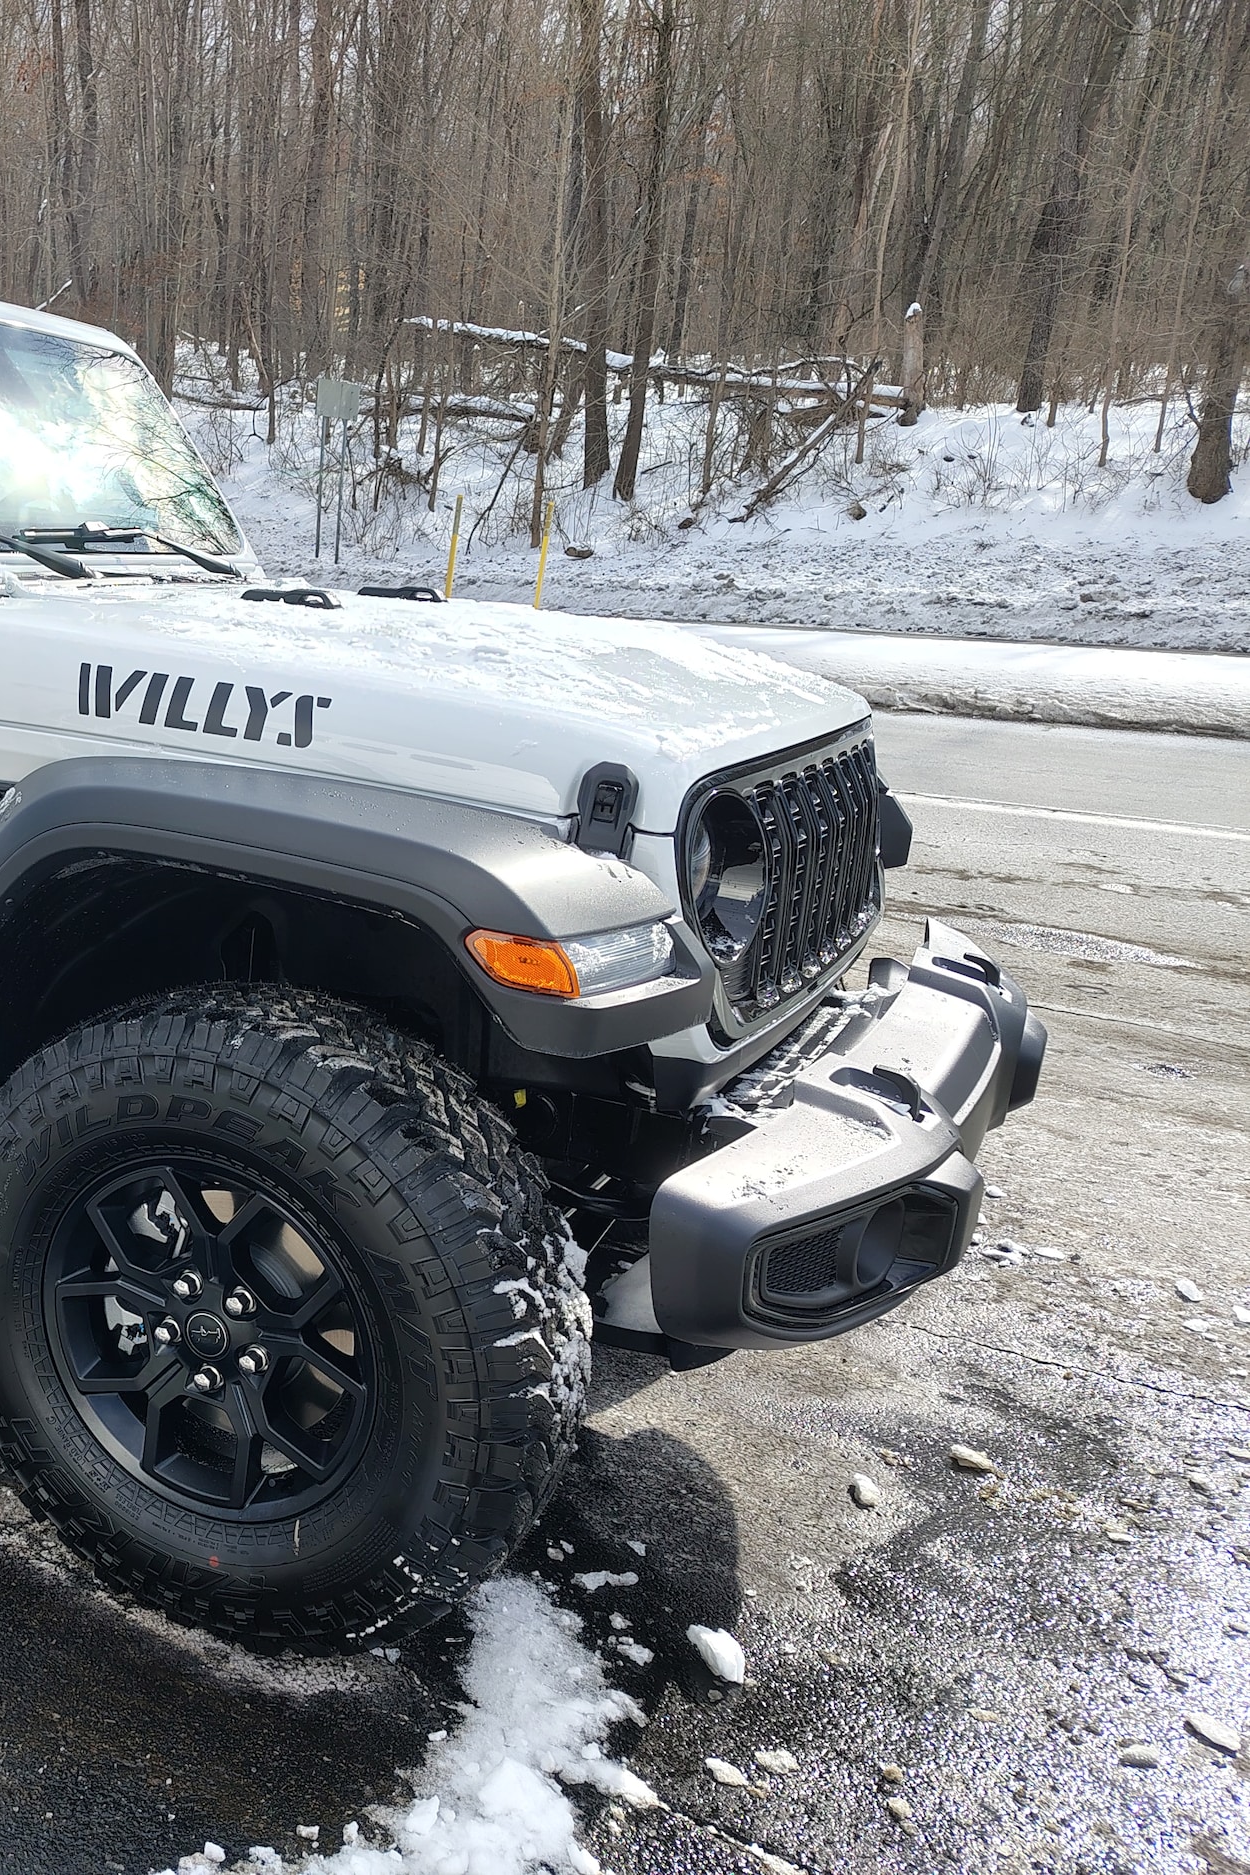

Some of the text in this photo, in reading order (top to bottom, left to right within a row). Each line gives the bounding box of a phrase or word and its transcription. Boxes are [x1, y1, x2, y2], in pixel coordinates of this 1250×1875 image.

[78, 662, 332, 748] WILLYS
[20, 1092, 362, 1213] WILDPEAK
[362, 1246, 439, 1401] M/T
[10, 1417, 278, 1602] FALKEN
